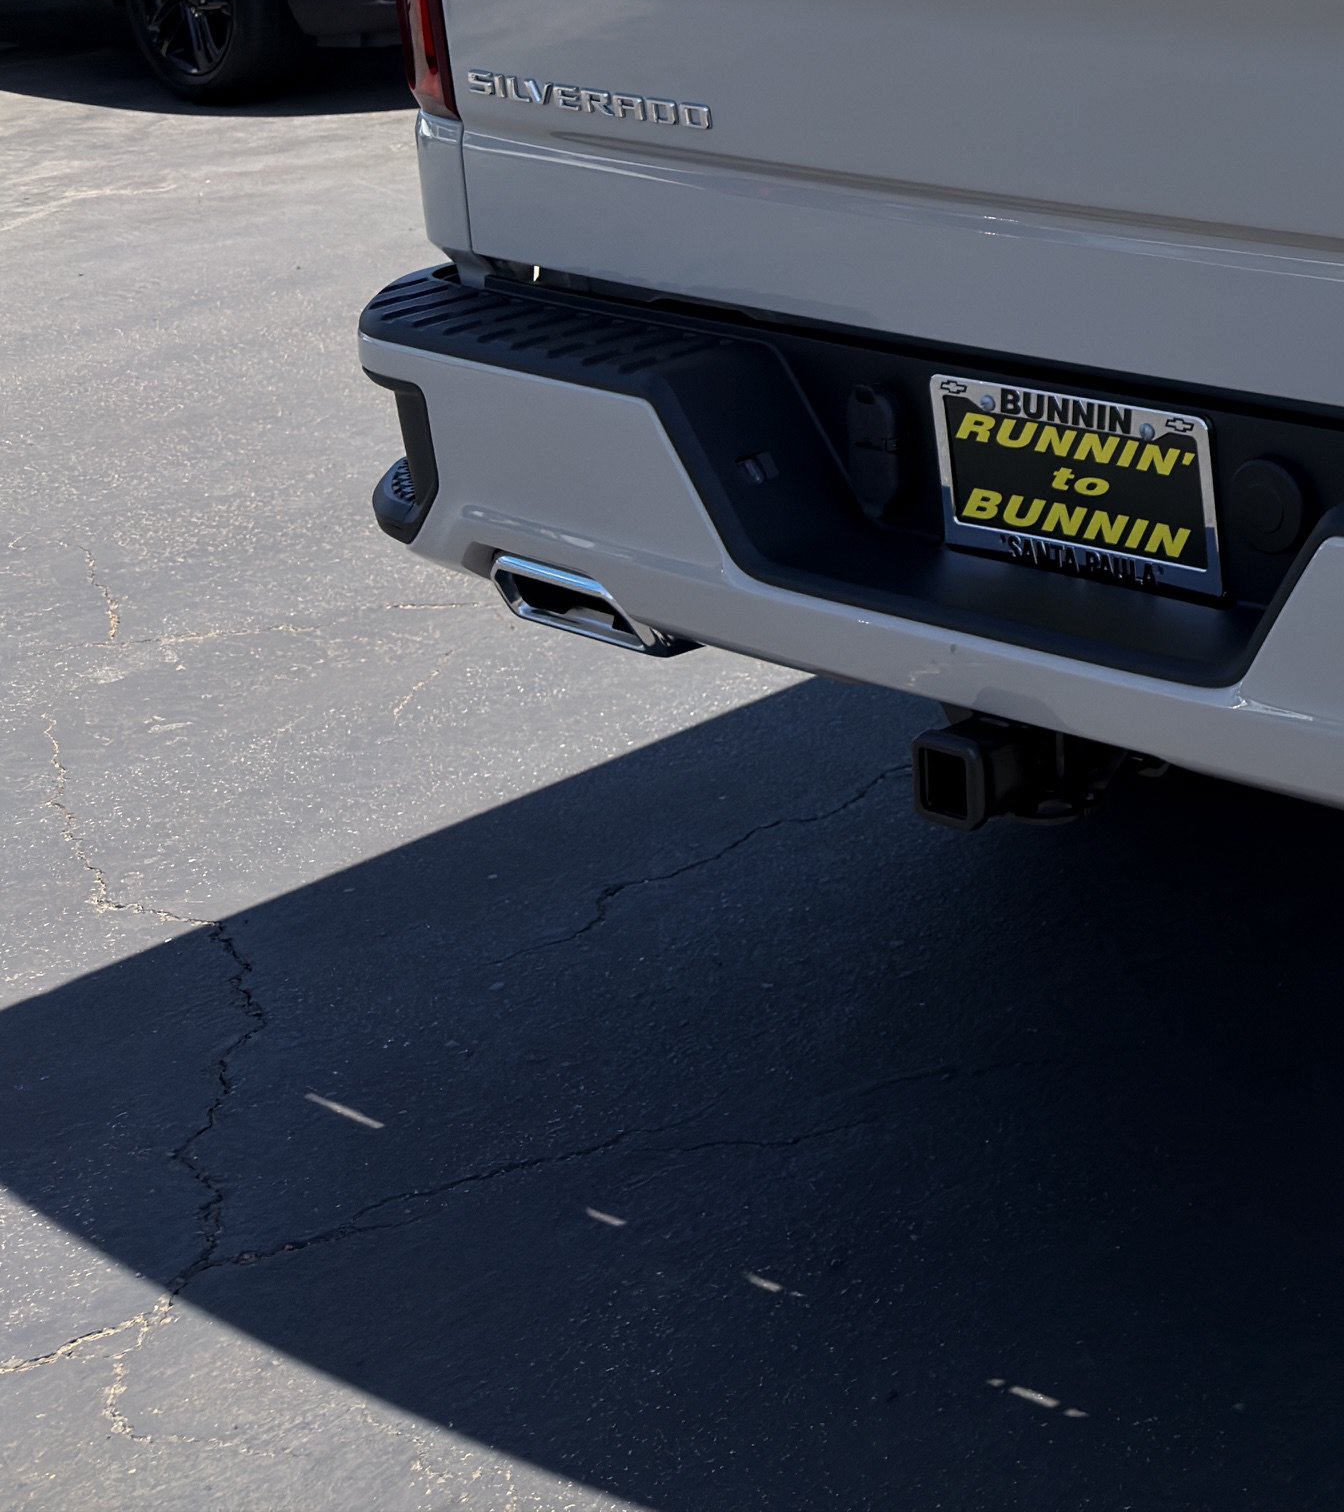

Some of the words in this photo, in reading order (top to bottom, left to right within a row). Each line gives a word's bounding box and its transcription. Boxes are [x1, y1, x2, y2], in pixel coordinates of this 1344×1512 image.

[467, 69, 713, 130] SILVERADO
[1000, 388, 1133, 434] BUNNIN
[956, 412, 1196, 476] RUNNIN'
[1052, 467, 1110, 496] to
[962, 488, 1191, 558] BUNNIN
